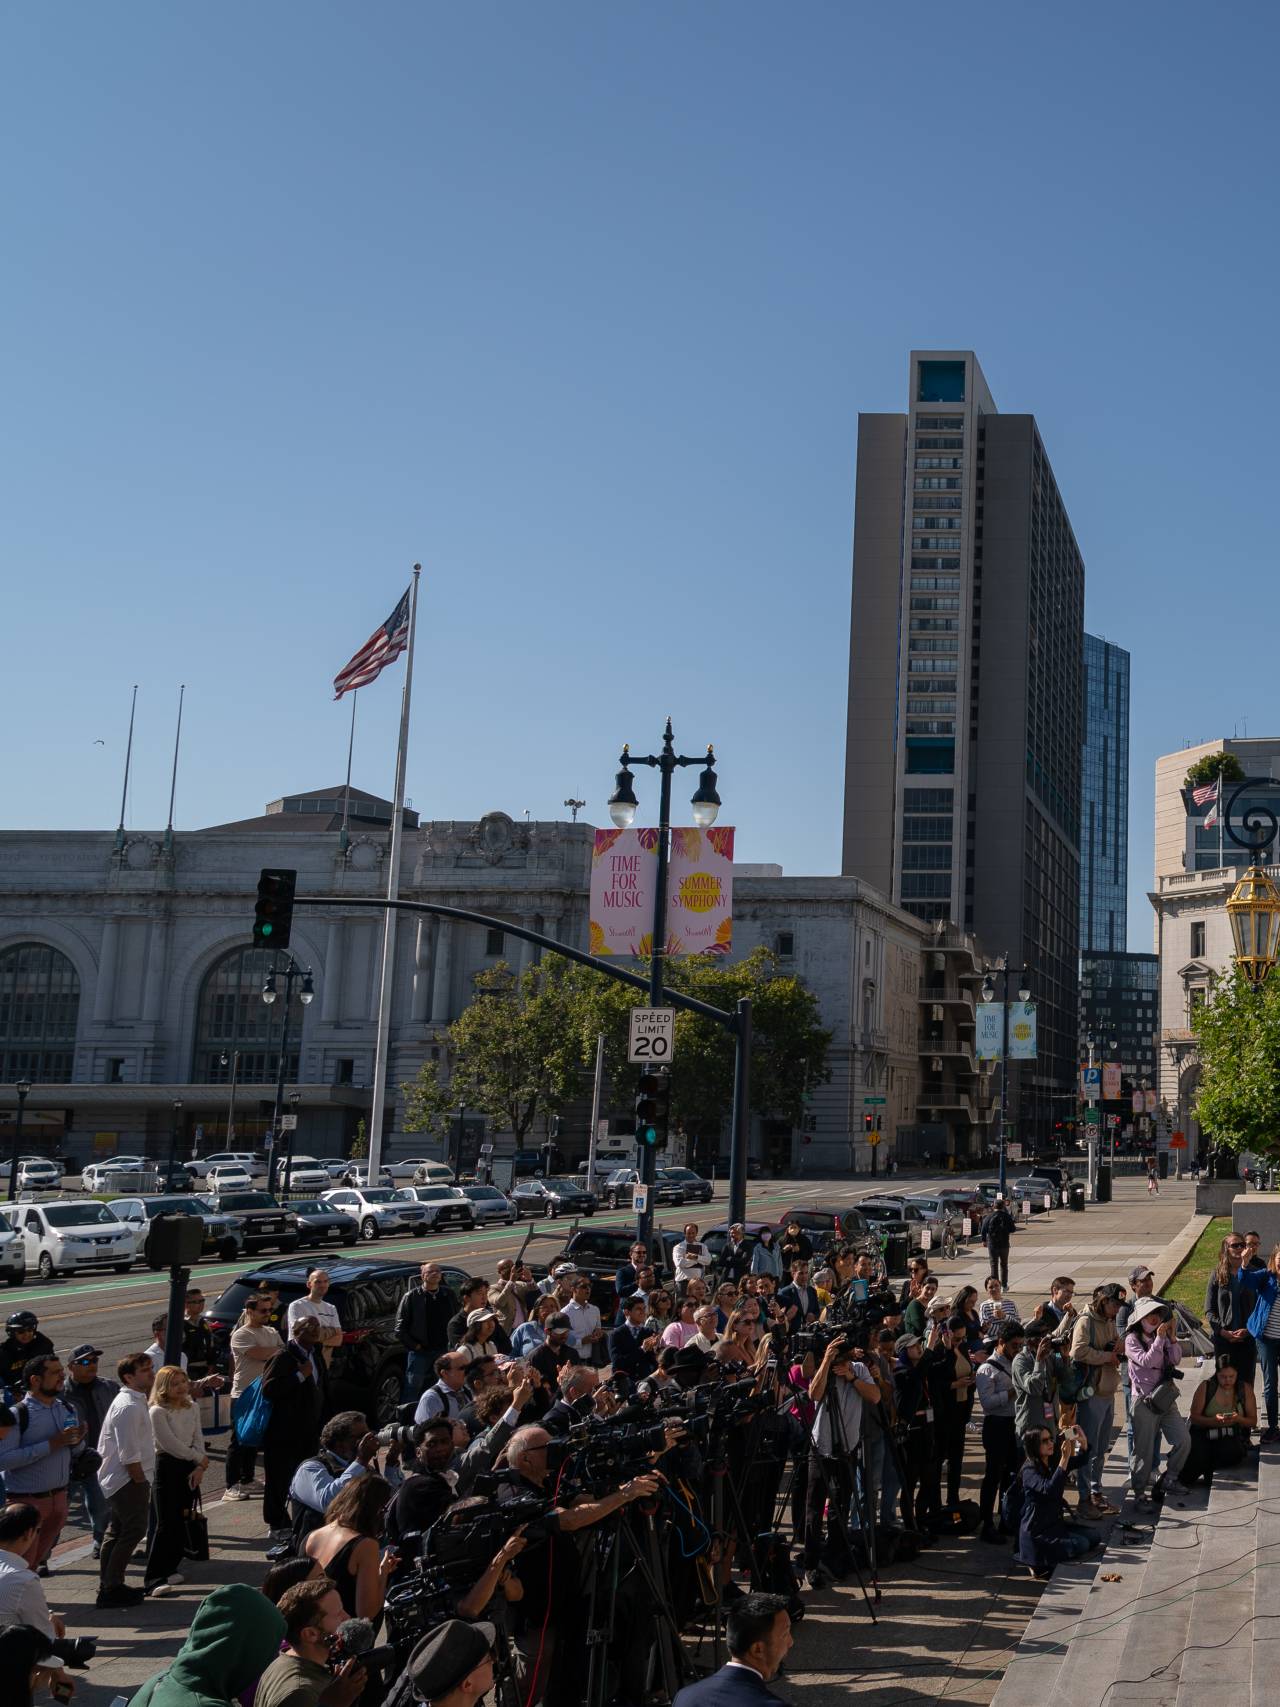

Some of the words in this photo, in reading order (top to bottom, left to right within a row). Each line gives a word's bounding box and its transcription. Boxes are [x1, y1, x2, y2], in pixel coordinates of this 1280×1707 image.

[610, 855, 641, 871] TIME
[612, 873, 637, 889] FOR
[678, 876, 722, 890] SUMMER
[603, 890, 644, 908] MUSIC
[671, 894, 728, 908] SYMPHONY
[634, 1014, 671, 1023] SPEED
[637, 1025, 667, 1034] LIMIT
[634, 1036, 668, 1057] 20
